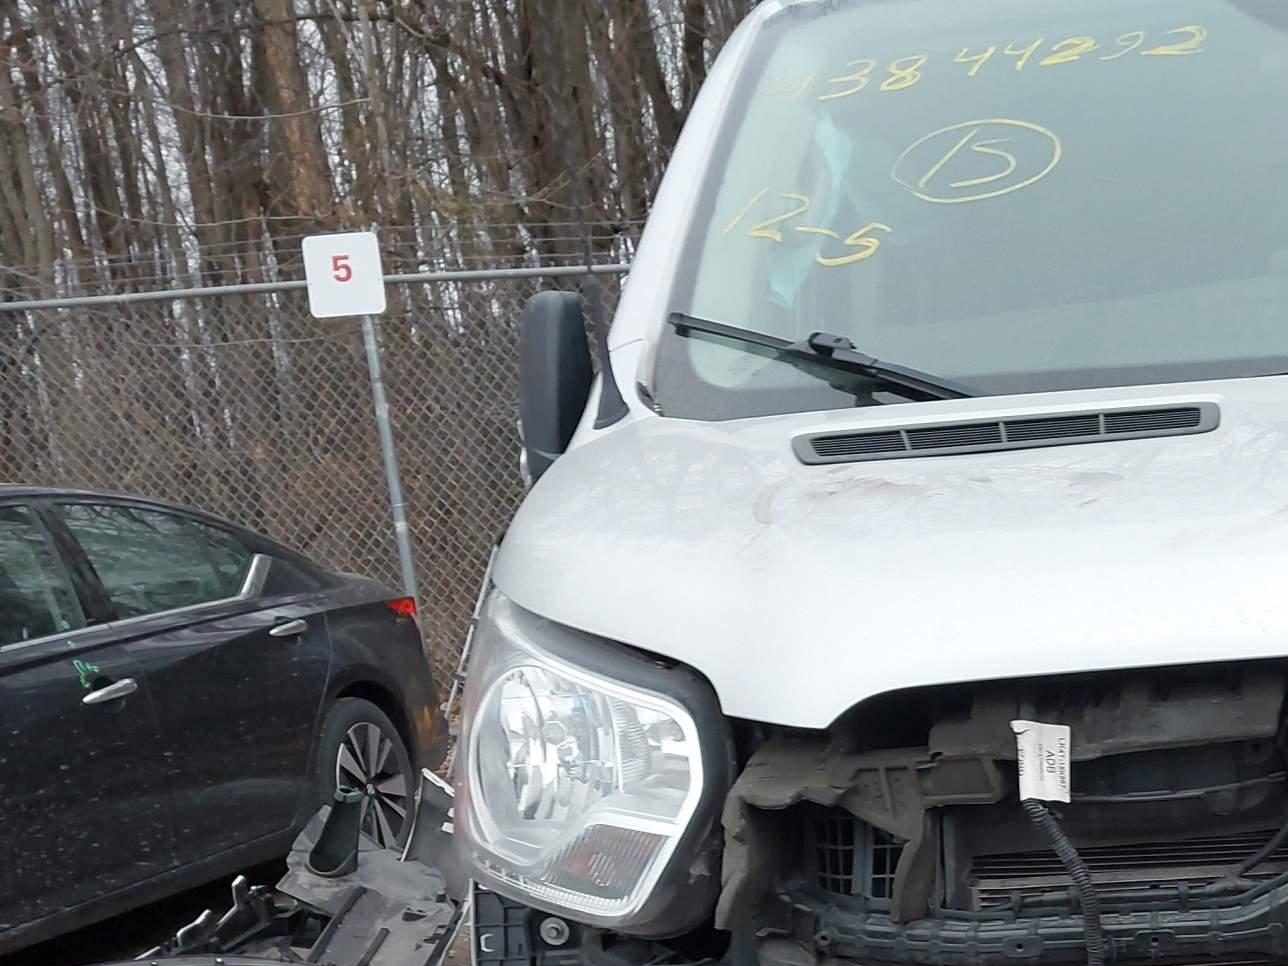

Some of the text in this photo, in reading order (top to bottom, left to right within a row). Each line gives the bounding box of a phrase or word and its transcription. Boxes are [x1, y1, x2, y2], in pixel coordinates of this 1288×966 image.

[920, 127, 1017, 188] 15
[722, 187, 893, 267] 12-5
[331, 254, 353, 283] 5
